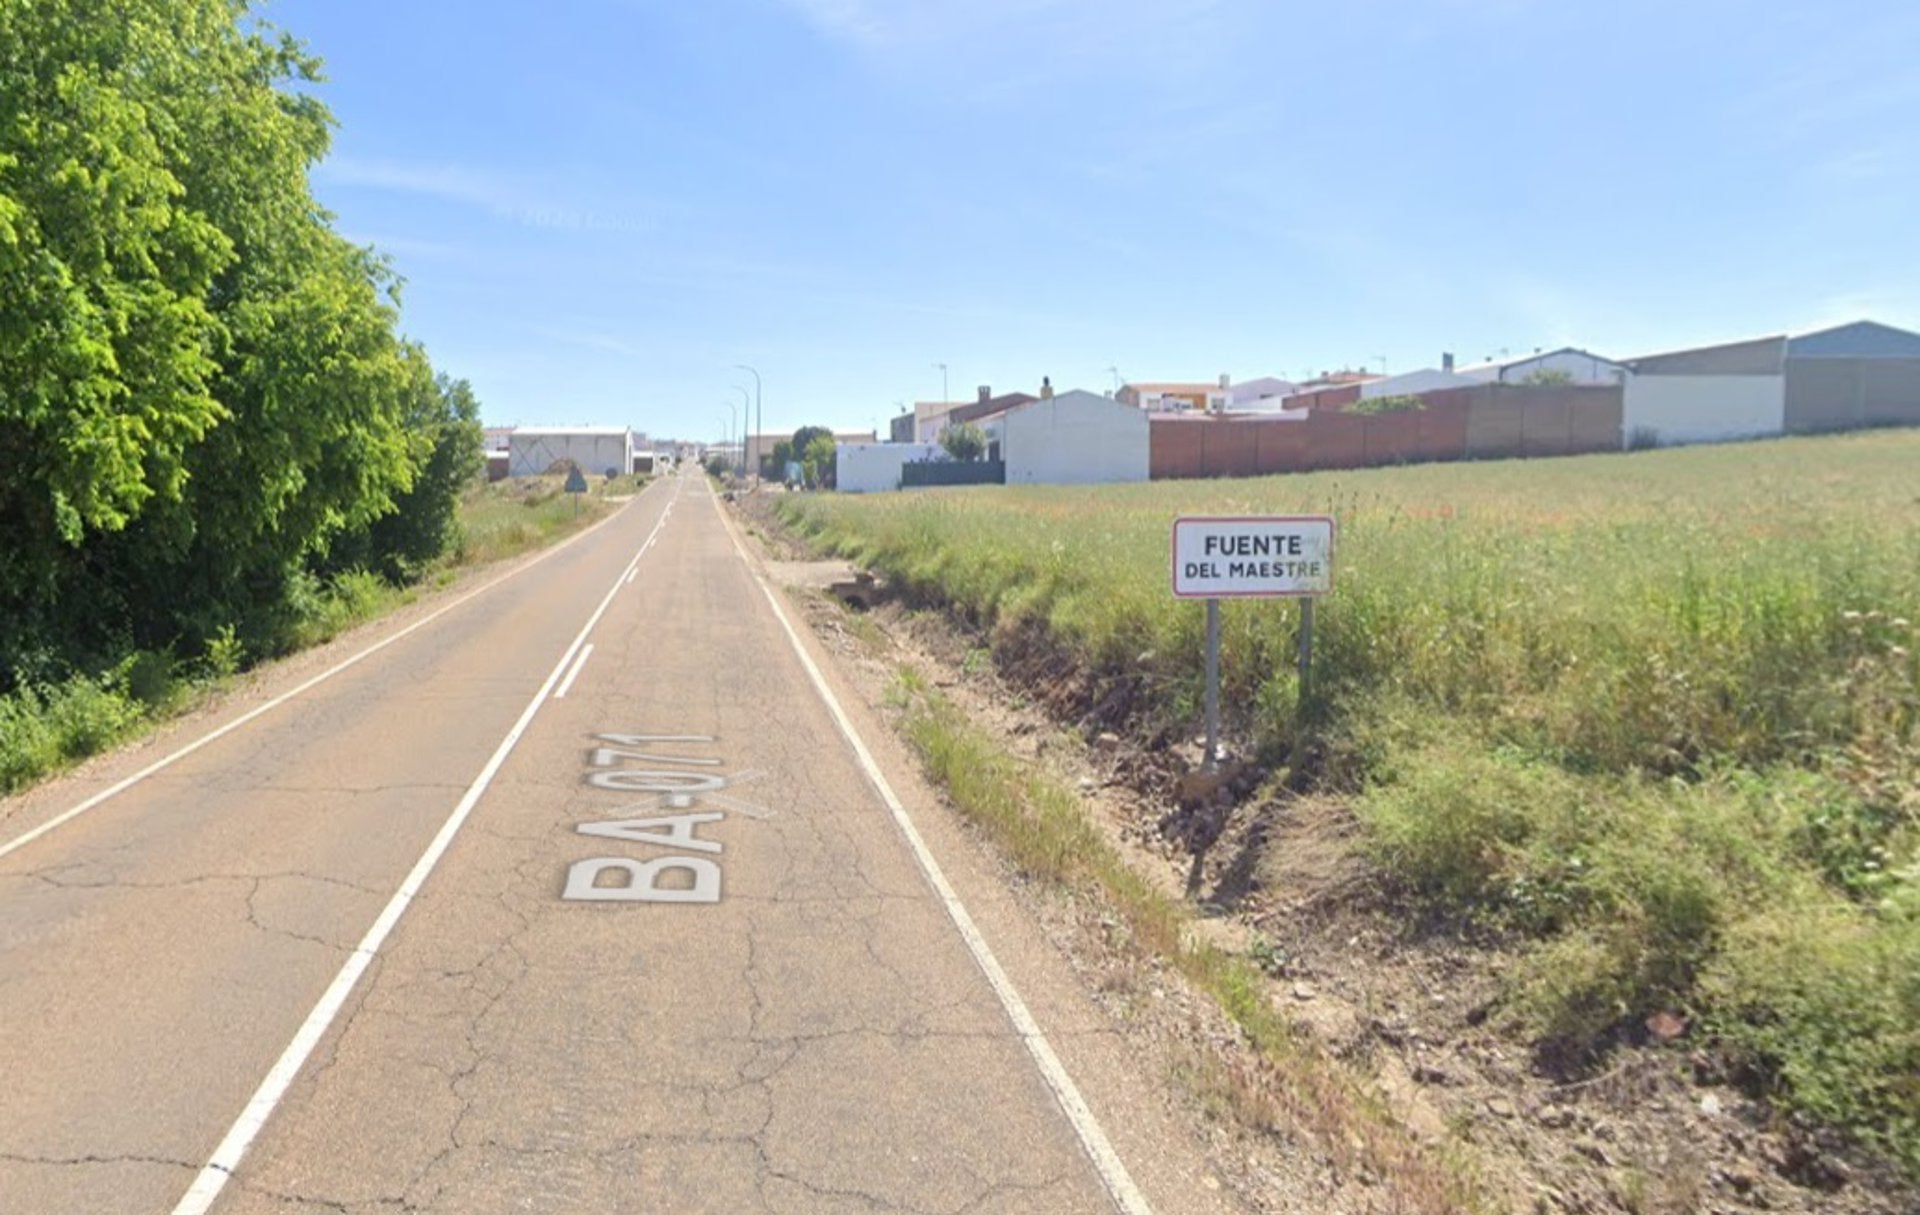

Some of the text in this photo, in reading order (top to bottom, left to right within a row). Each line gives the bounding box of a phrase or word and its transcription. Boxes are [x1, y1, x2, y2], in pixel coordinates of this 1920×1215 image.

[1205, 535, 1302, 556] FUENTE
[1185, 561, 1320, 579] DEL MAESTRE
